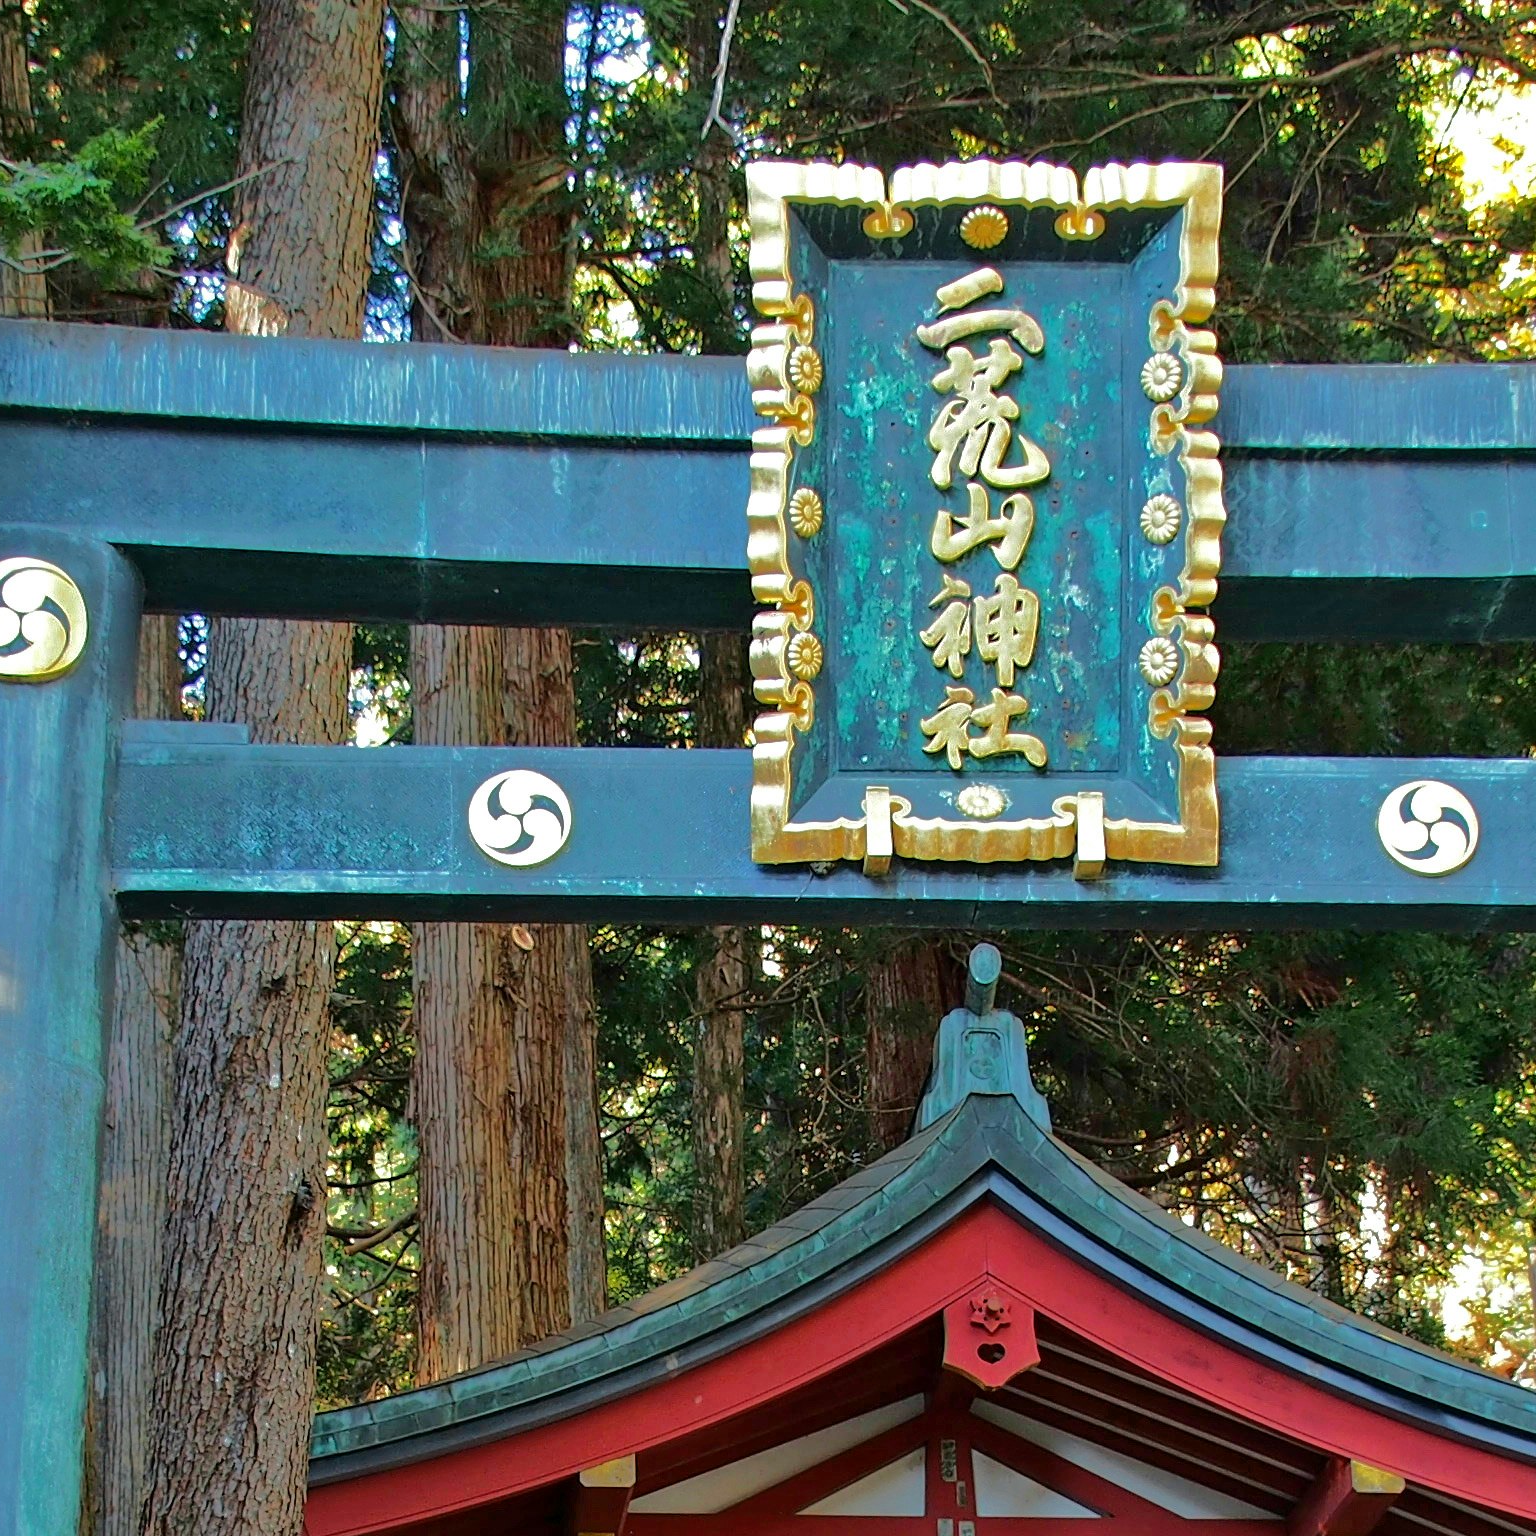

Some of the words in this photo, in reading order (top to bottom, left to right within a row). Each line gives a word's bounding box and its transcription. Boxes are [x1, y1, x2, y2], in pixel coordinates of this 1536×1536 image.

[916, 267, 1050, 769] 二荒山神社
